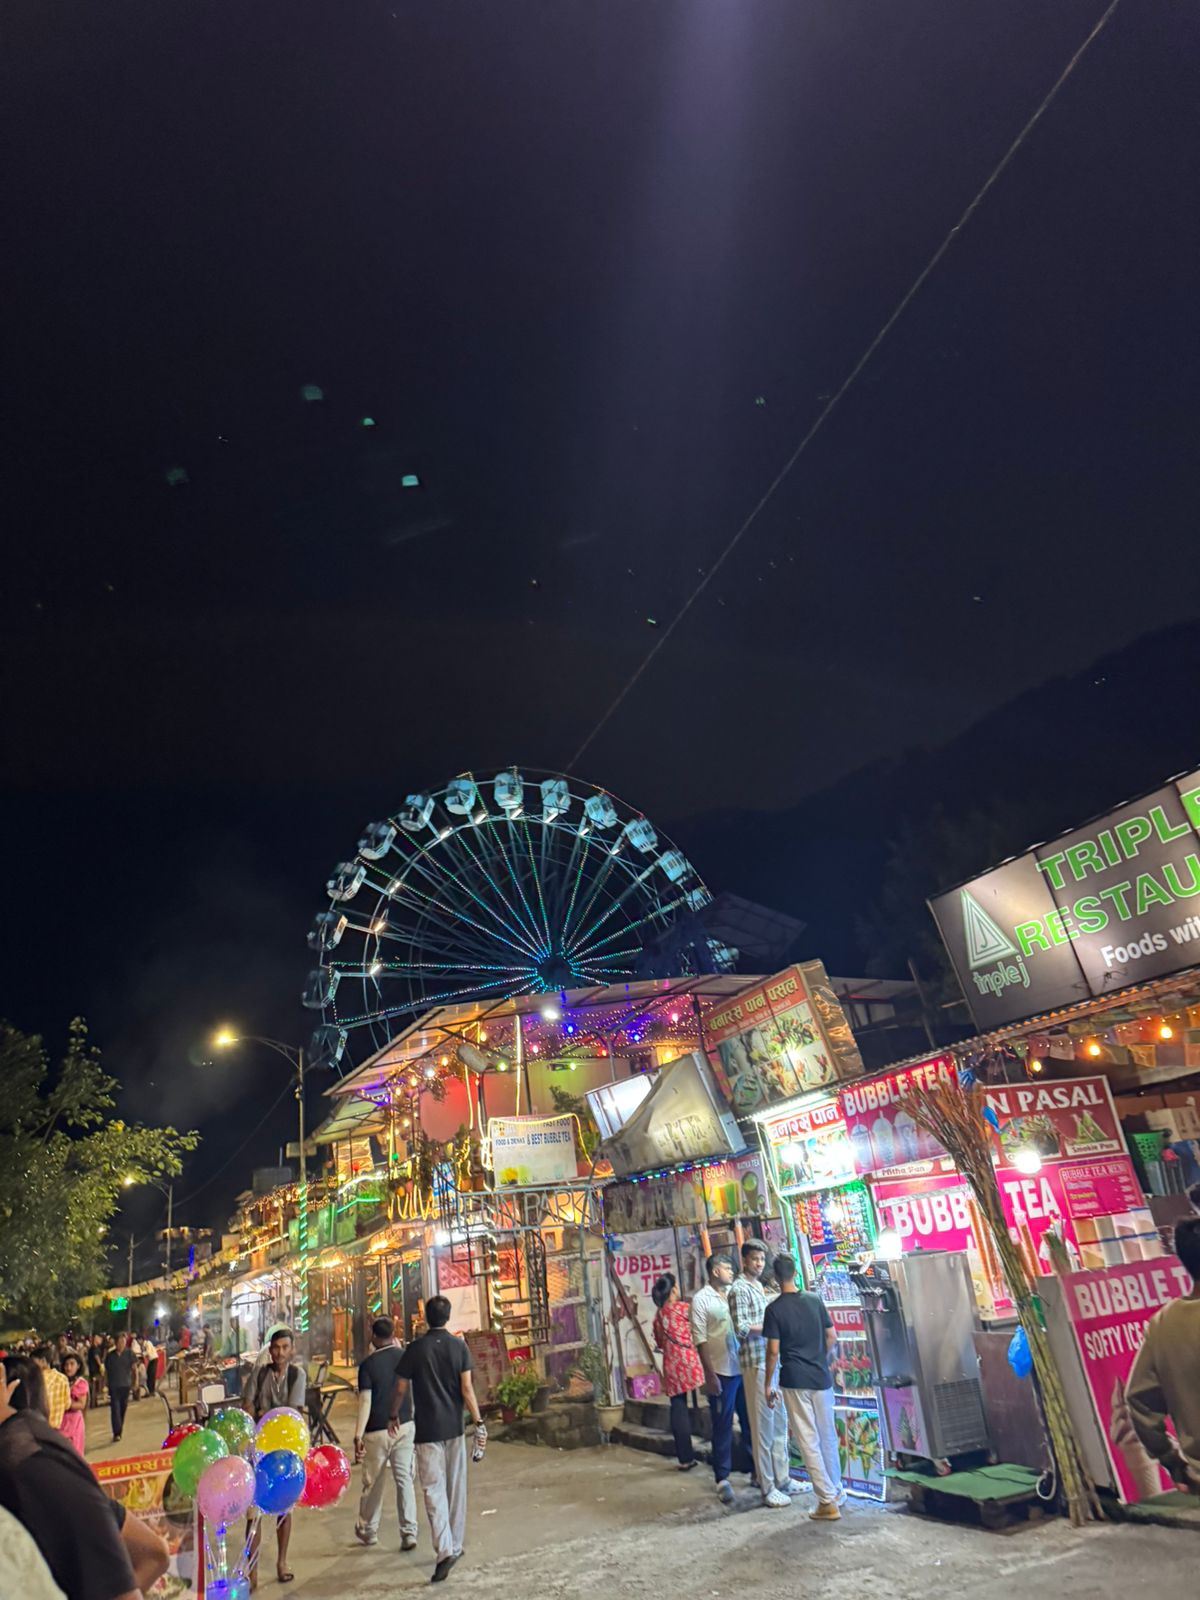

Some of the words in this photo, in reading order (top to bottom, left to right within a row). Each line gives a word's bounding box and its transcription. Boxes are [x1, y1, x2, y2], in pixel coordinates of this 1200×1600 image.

[1101, 932, 1168, 968] Foods
[744, 993, 767, 1013] पान
[767, 977, 799, 1002] पसल
[843, 1074, 910, 1117] BUBBLE
[911, 1061, 952, 1093] TEA
[1016, 1084, 1104, 1112] PASAL
[810, 1105, 840, 1125] पान
[543, 1132, 561, 1144] BUBBLE
[561, 1131, 572, 1143] TEA
[704, 1163, 726, 1180] GOLA
[1061, 1167, 1090, 1181] BUBBLE
[1090, 1165, 1108, 1177] TEA
[524, 1186, 594, 1226] PARK
[893, 1192, 971, 1238] BUBB
[1003, 1177, 1062, 1219] TEA
[615, 1254, 671, 1277] UBBLE
[1074, 1270, 1172, 1319] BUBBLE
[833, 1310, 861, 1325] पान
[1083, 1324, 1124, 1360] SOFTY
